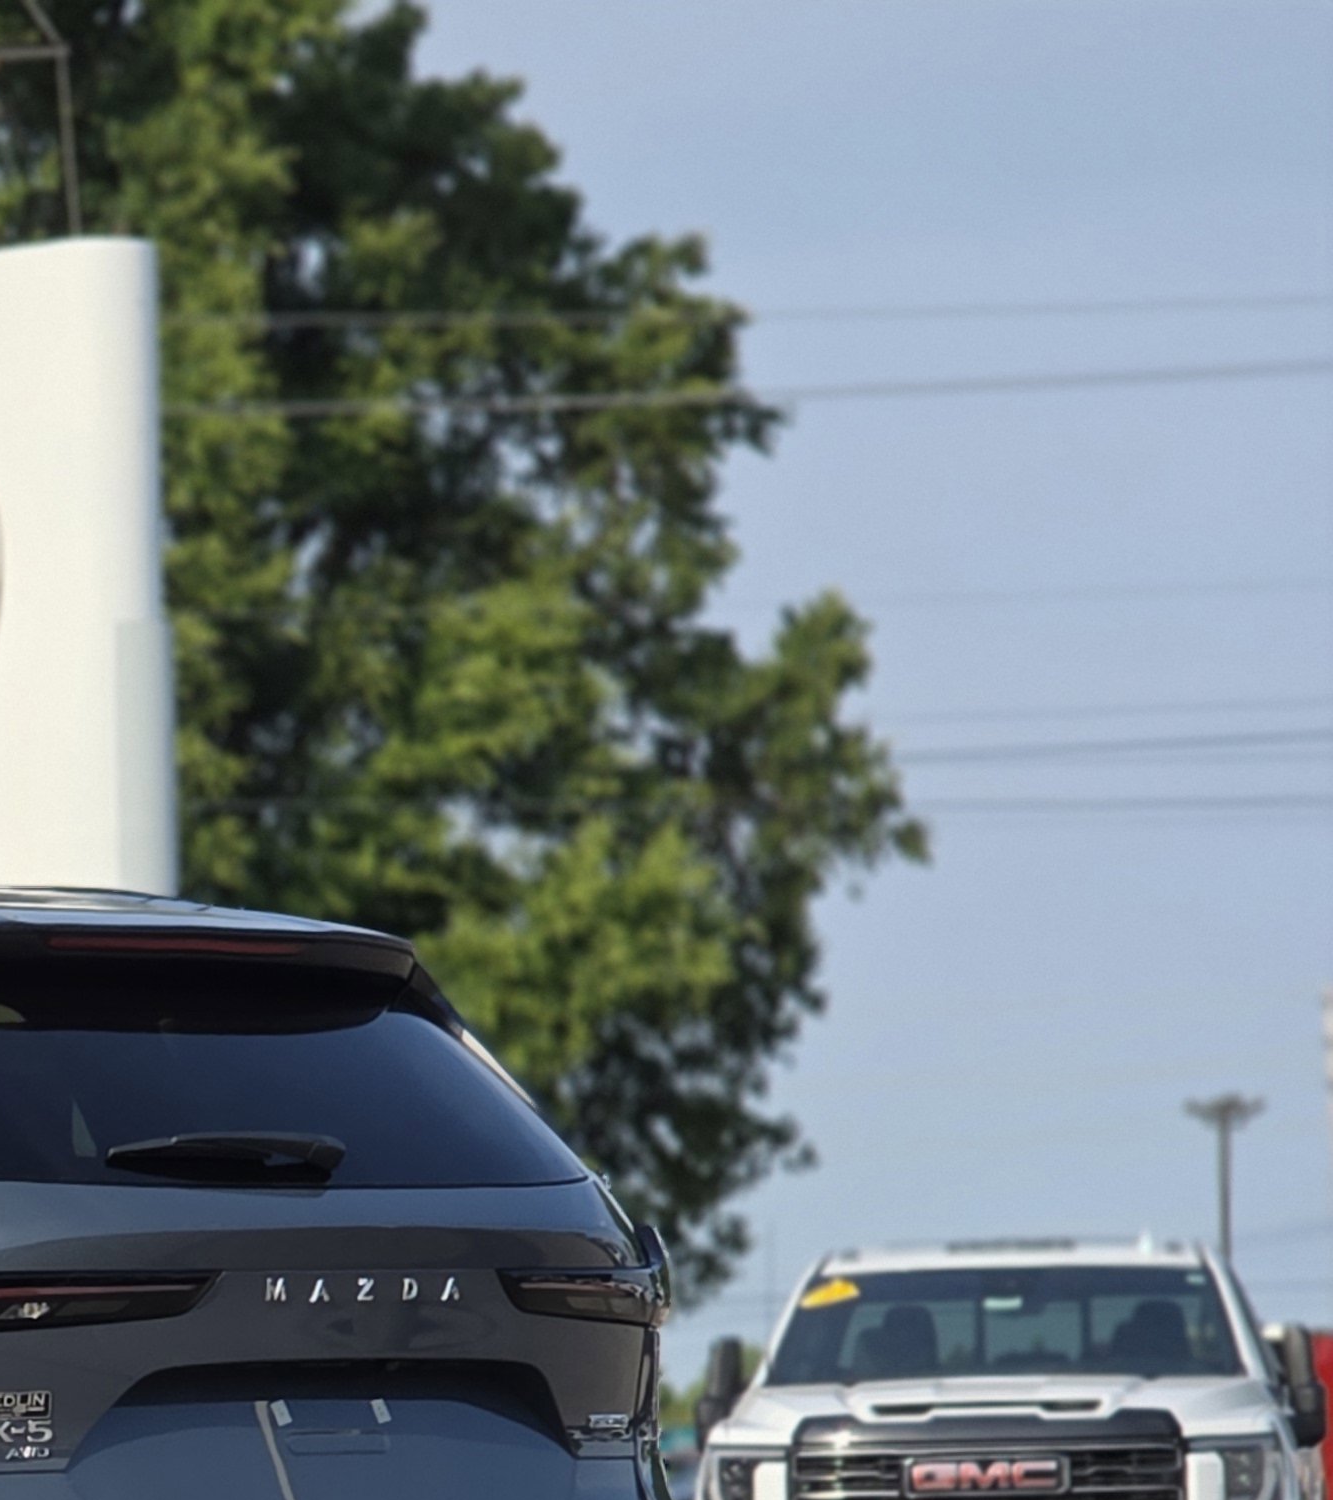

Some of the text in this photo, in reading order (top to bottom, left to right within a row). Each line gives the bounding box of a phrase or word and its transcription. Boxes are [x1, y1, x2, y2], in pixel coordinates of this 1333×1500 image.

[264, 1276, 461, 1303] MAZDA
[5, 1446, 51, 1460] AWD
[911, 1459, 1058, 1490] GMC
